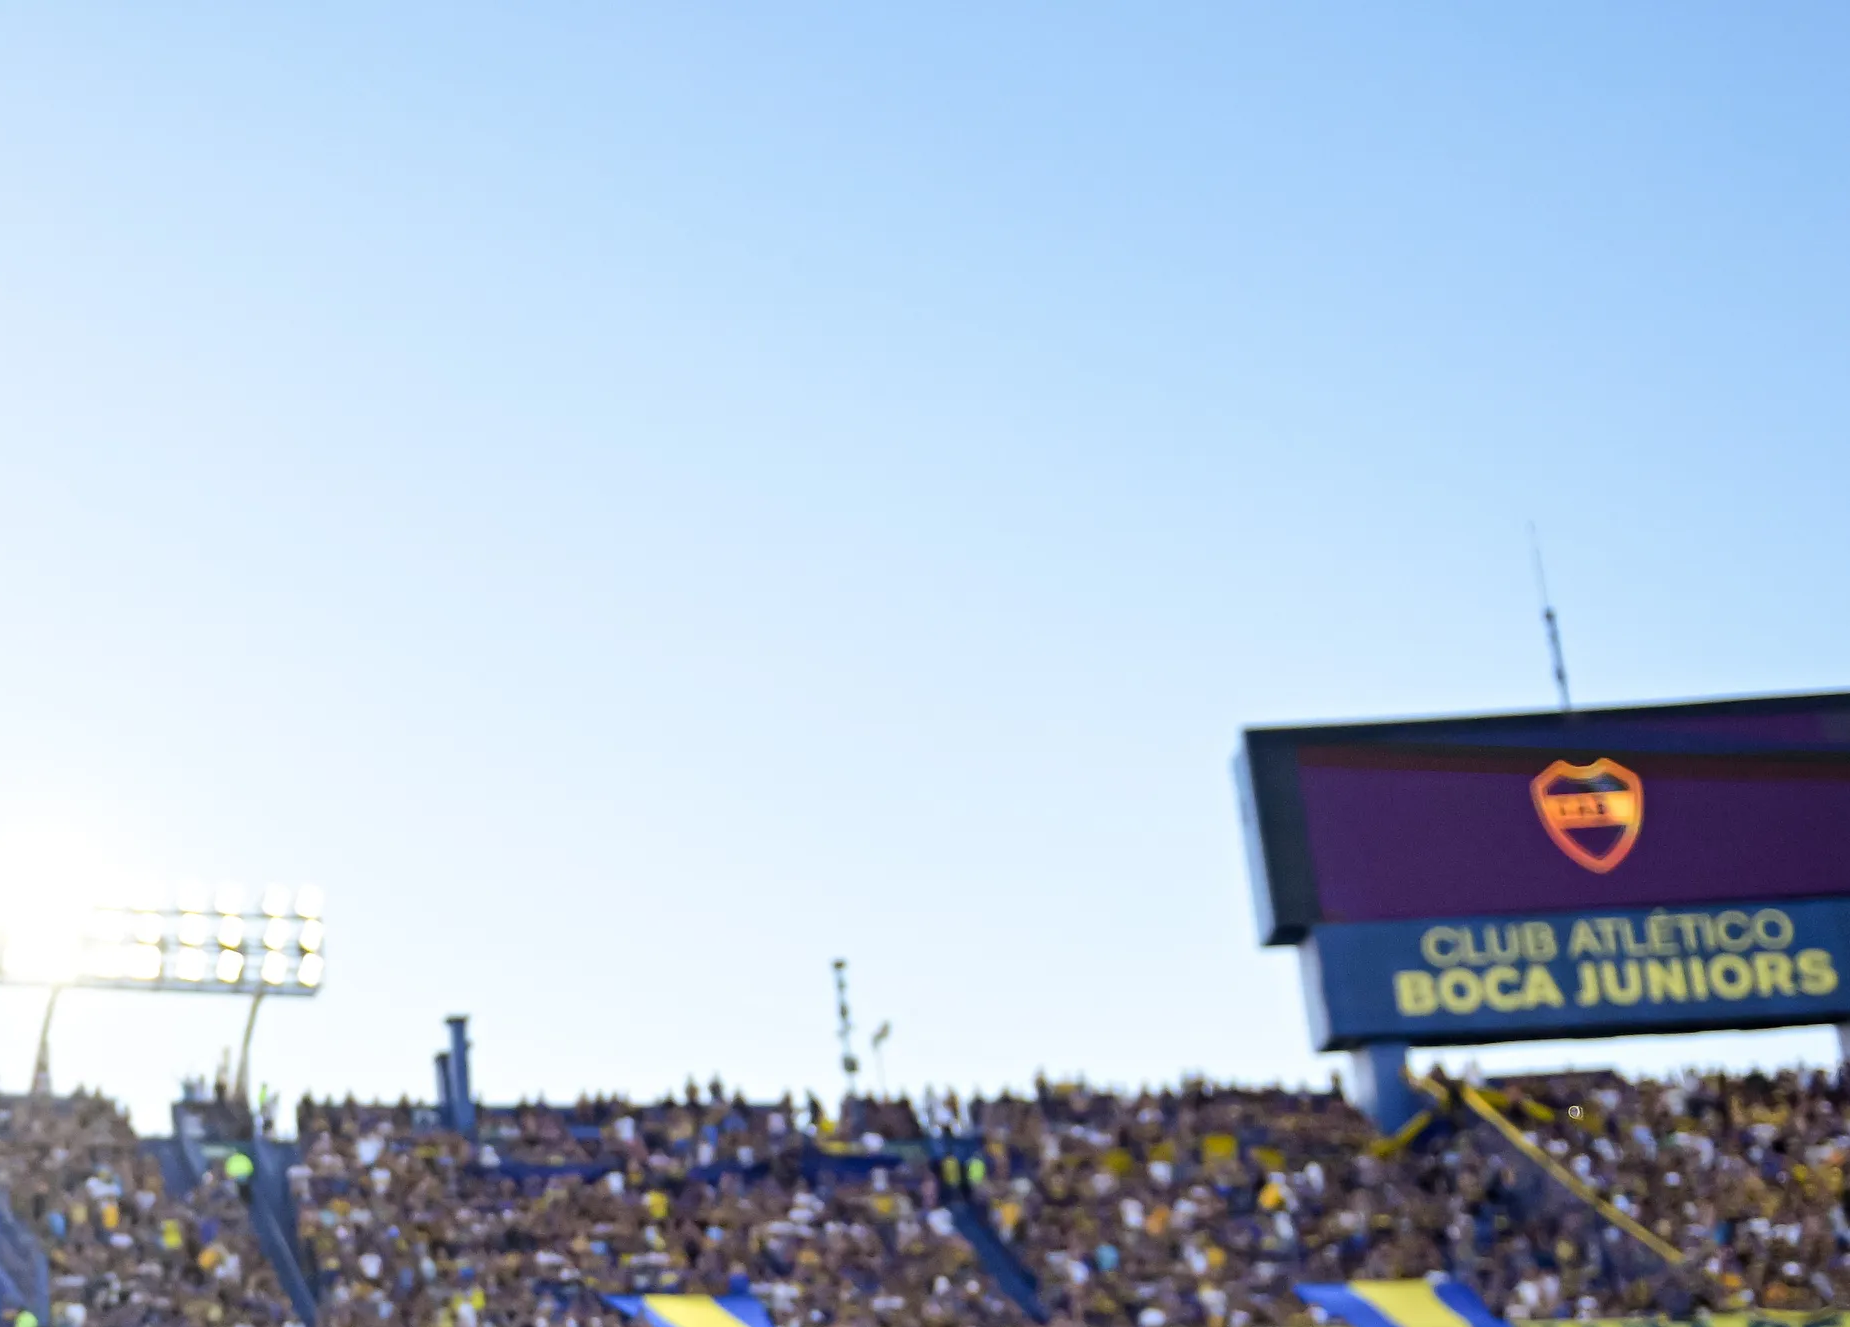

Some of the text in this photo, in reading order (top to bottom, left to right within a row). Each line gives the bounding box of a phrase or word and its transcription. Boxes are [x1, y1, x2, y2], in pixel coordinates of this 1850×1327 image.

[1421, 906, 1794, 968] CLUB ATLÉTICO
[1394, 948, 1839, 1017] BOCA JUNIORS
